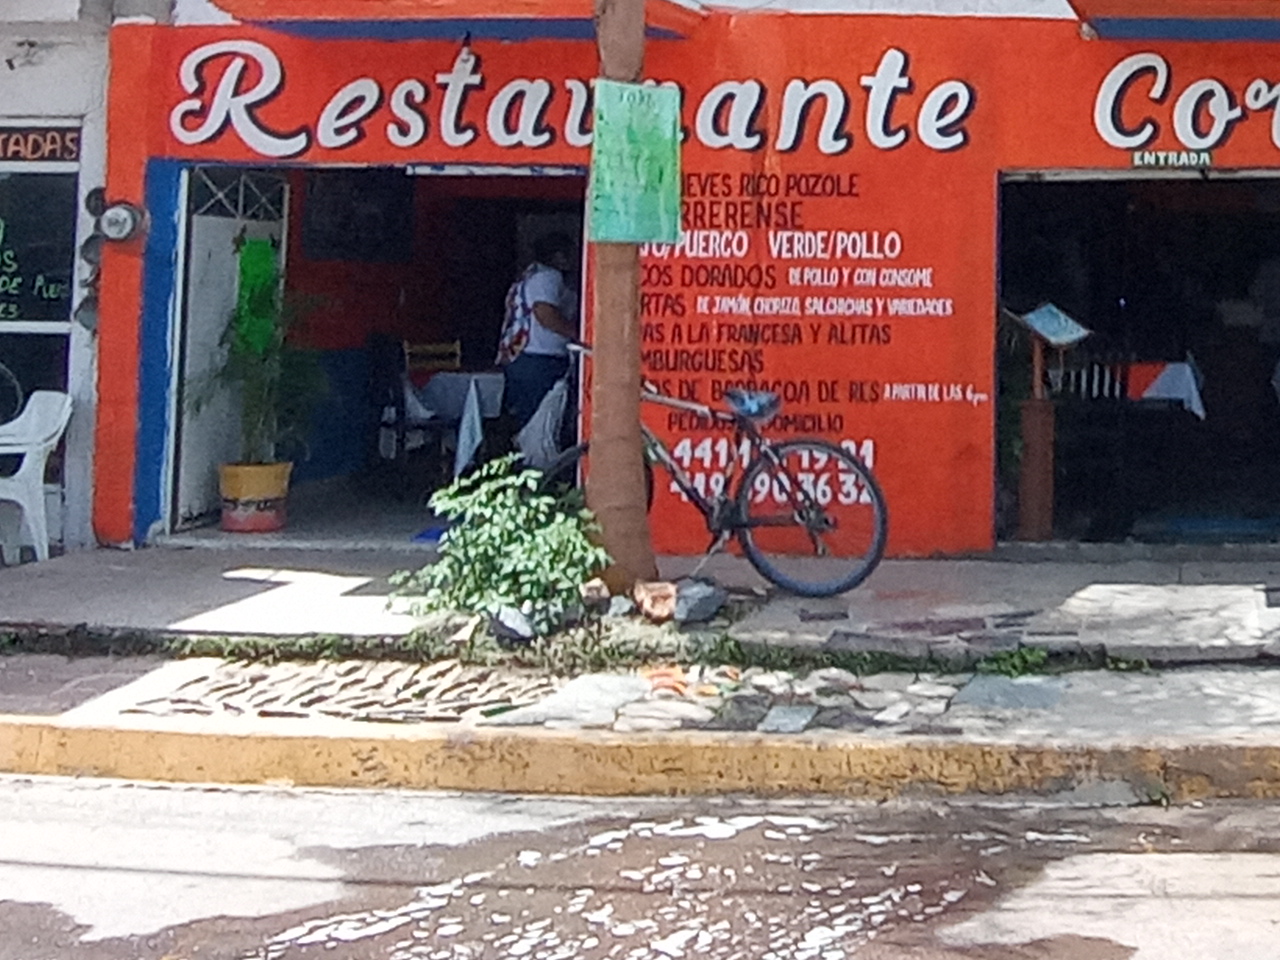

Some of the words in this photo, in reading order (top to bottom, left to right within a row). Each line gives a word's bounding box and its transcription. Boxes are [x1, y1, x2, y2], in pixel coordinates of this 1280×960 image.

[170, 40, 974, 157] Restauante
[1133, 151, 1211, 166] ENTRADA
[739, 174, 780, 198] RICO
[785, 174, 860, 198] POZOLE
[769, 230, 902, 260] VERDE/POLLO
[681, 263, 777, 289] DORADOS
[803, 266, 839, 287] POLLO
[841, 267, 851, 287] Y
[641, 293, 686, 317] RTAS
[875, 296, 885, 317] Y
[717, 323, 803, 345] FRANCESA
[810, 323, 822, 344] Y
[828, 323, 892, 346] ALITAS
[641, 348, 764, 372] MBURGUESAS
[818, 379, 840, 403] DE
[848, 379, 880, 404] RES
